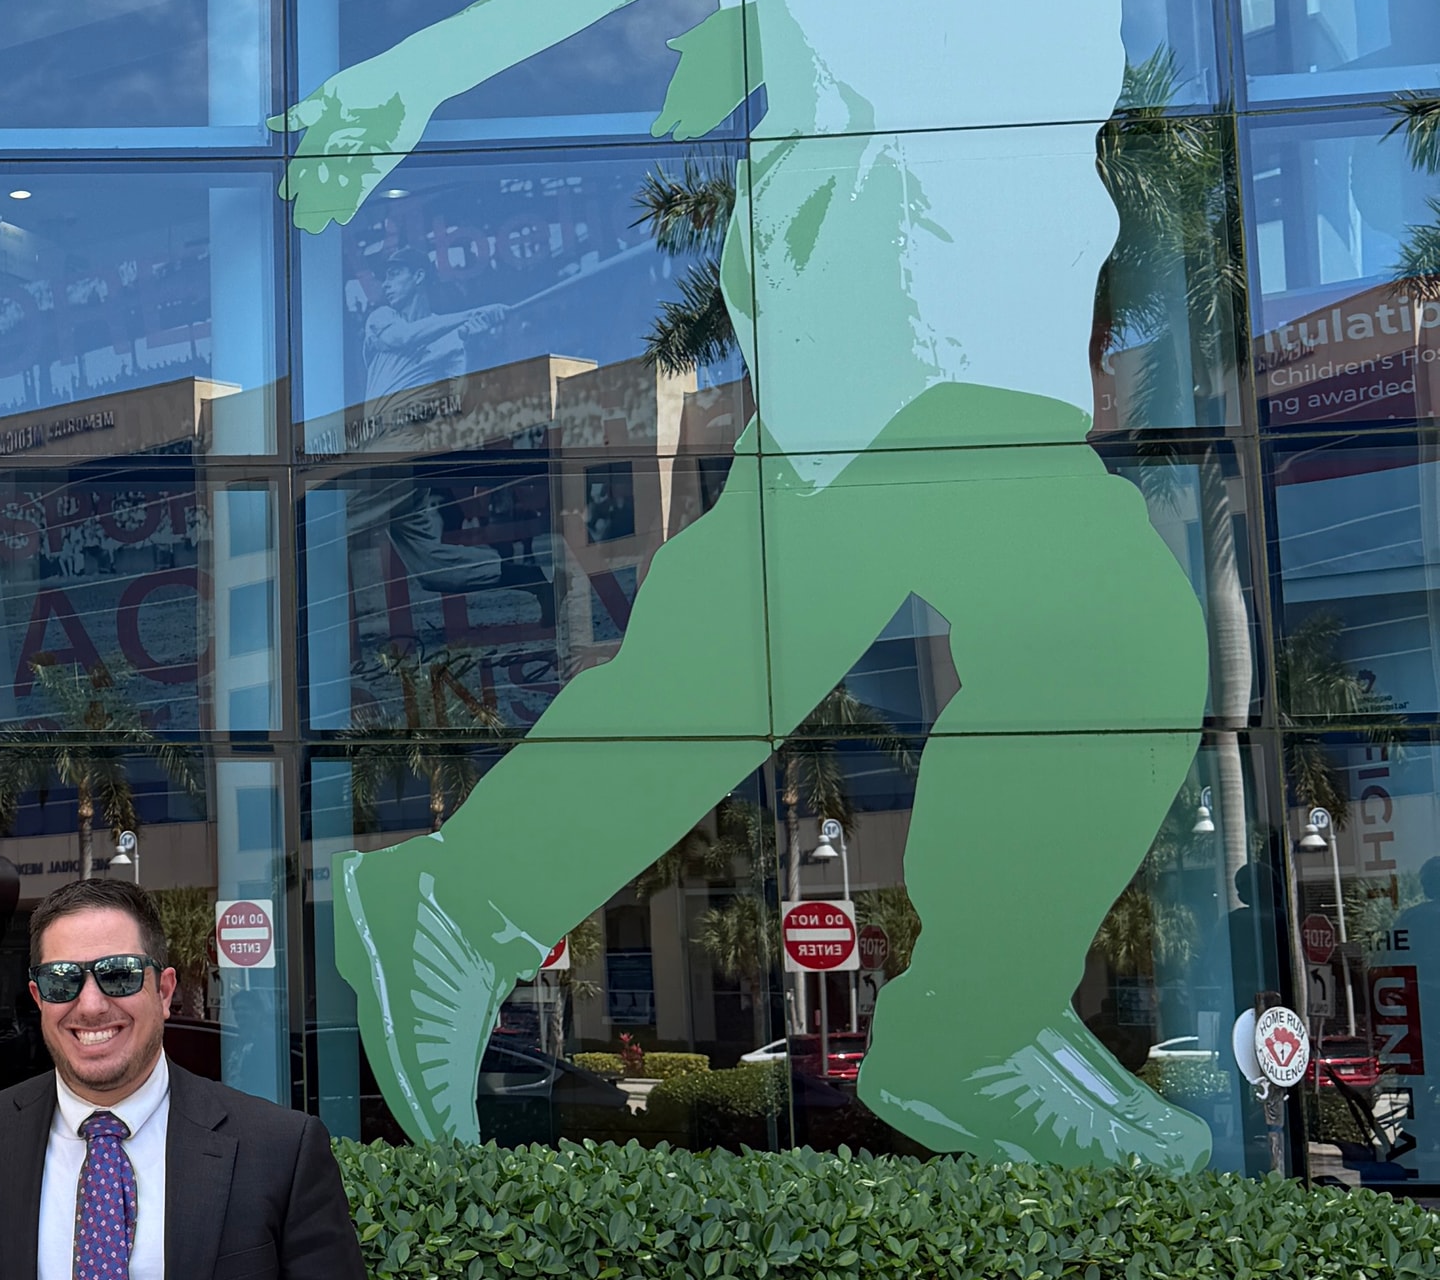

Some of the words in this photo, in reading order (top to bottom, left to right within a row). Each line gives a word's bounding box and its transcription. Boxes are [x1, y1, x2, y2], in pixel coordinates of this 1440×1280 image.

[1271, 353, 1394, 386] Children's
[1308, 375, 1416, 408] awarded
[1259, 1011, 1286, 1039] HOME
[1287, 1014, 1306, 1041] RUN
[1373, 977, 1412, 1065] UN
[1258, 1047, 1308, 1082] CHALLENGE
